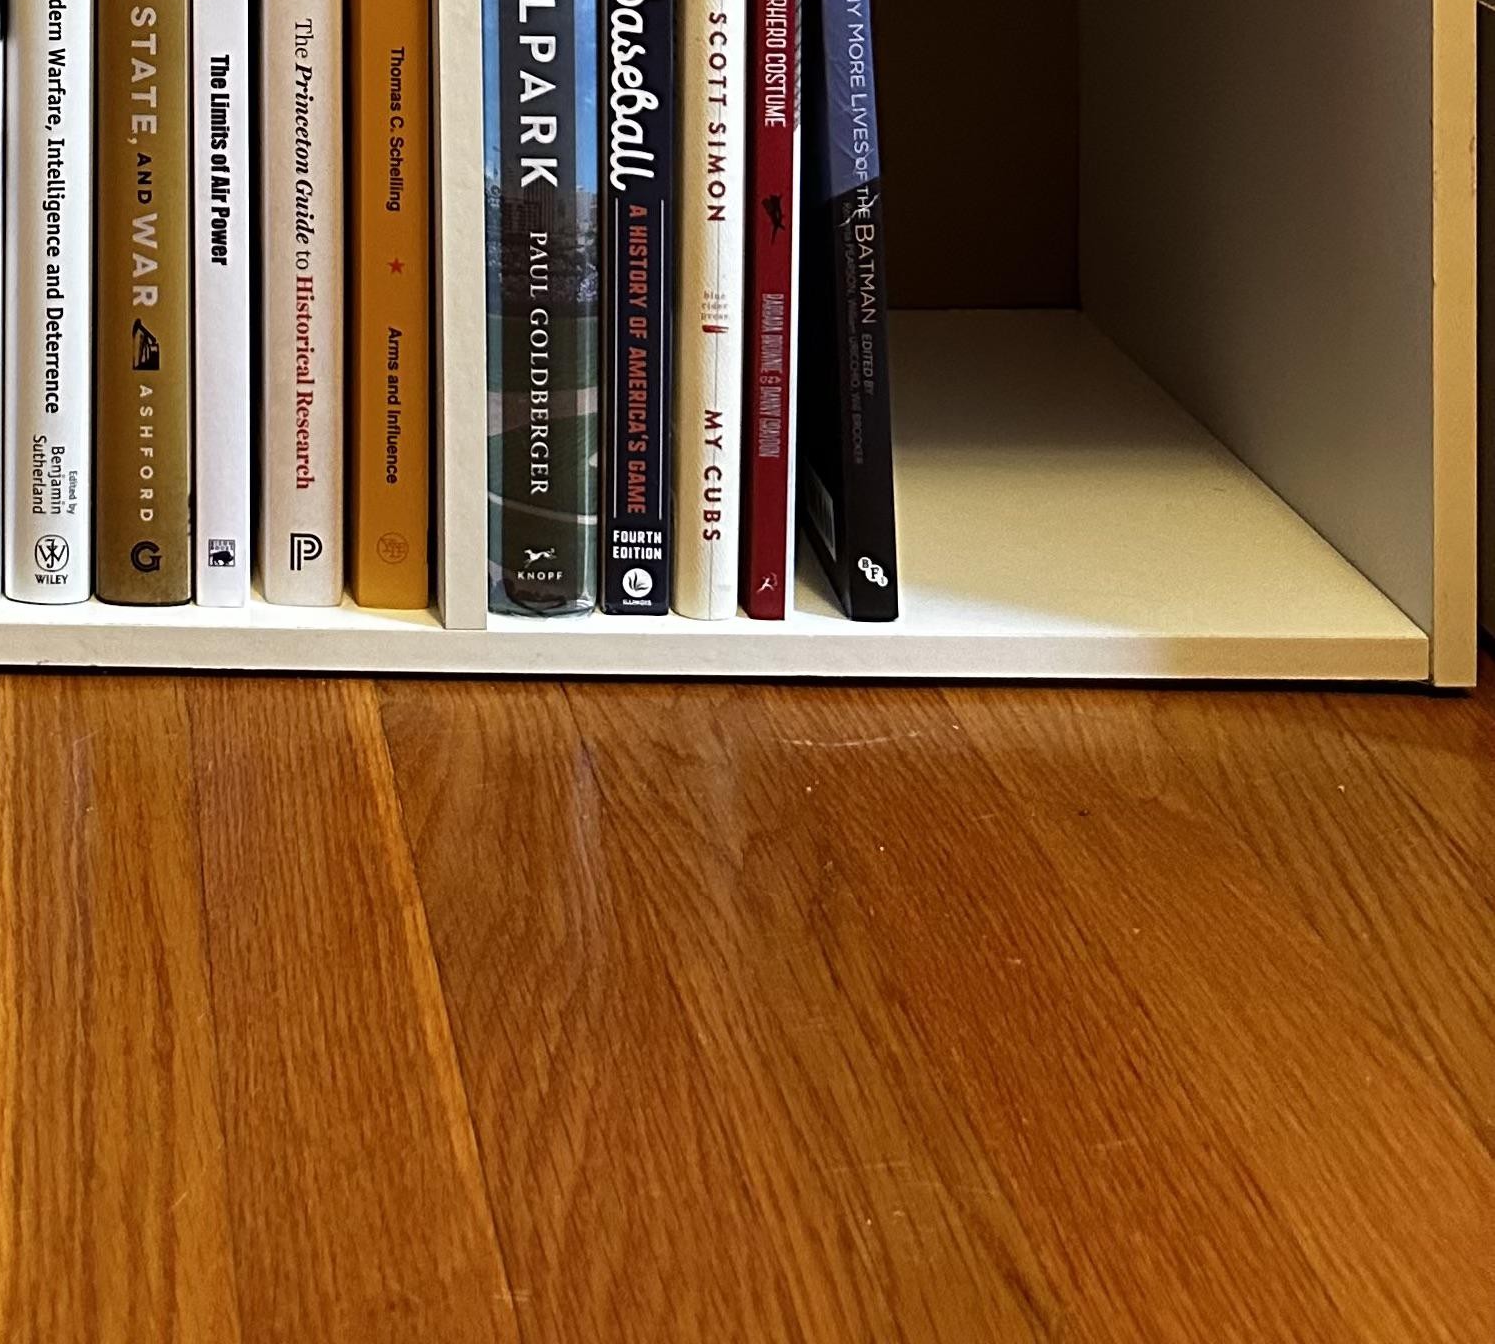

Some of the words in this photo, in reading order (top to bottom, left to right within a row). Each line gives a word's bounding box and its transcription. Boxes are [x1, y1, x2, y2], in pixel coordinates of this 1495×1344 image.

[127, 6, 157, 144] STATE,
[709, 13, 726, 107] SCOTT
[764, 53, 785, 127] COSTUME
[137, 153, 152, 204] AND
[707, 122, 726, 222] SIMON
[132, 213, 158, 305] WAR
[529, 232, 548, 297] PAUL
[387, 328, 402, 371] Arms
[386, 376, 402, 406] and
[529, 309, 548, 495] GOLDBERGER
[386, 410, 401, 484] Influence
[705, 409, 723, 456] MY
[614, 529, 661, 542] FOURTH
[703, 465, 721, 542] CUBS
[613, 546, 662, 560] EDITION
